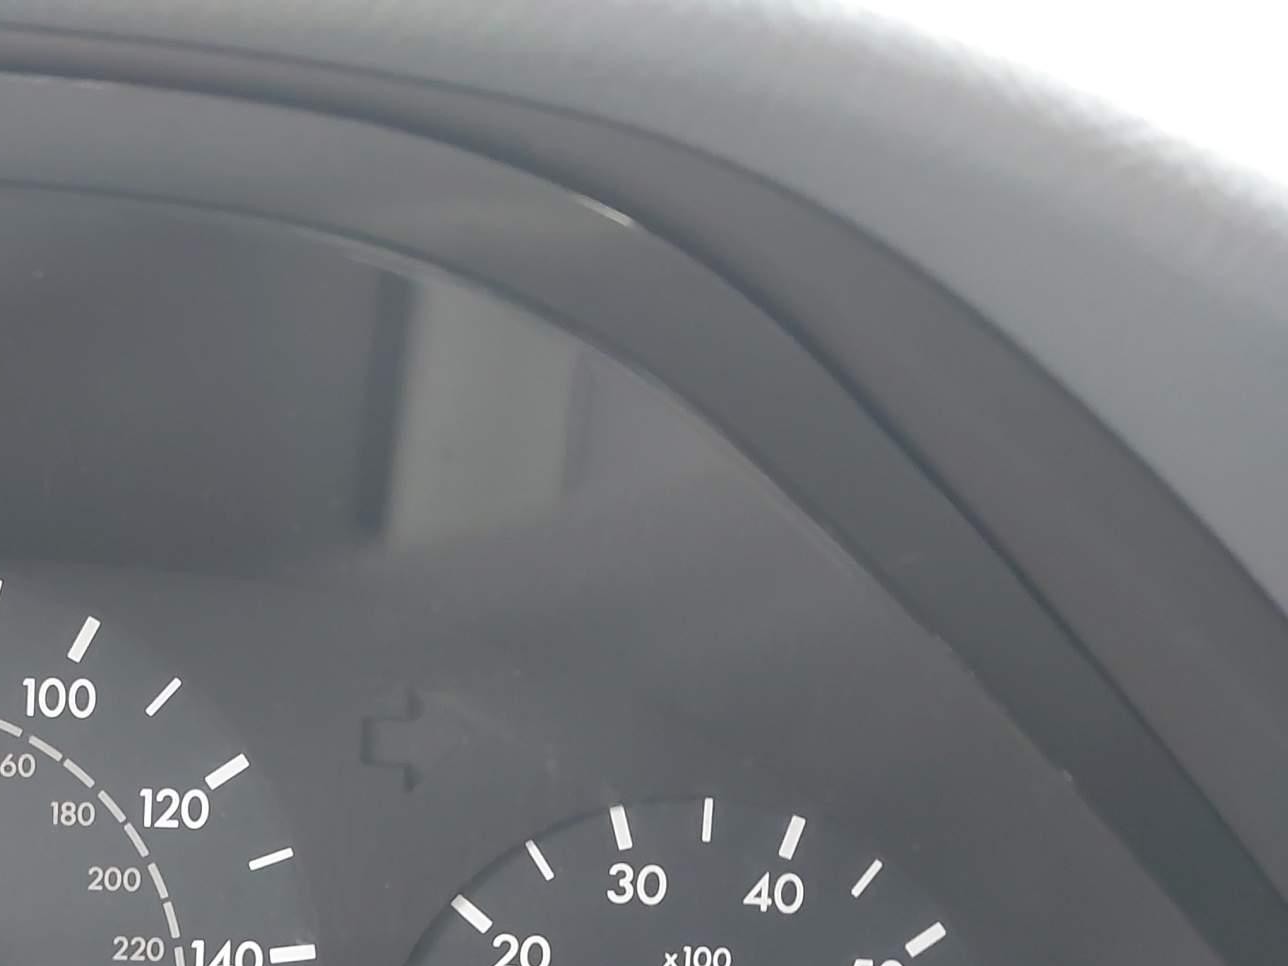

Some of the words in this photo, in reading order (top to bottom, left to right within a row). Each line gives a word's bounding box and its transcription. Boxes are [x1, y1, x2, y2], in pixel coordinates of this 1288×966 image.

[22, 677, 97, 719] 100
[50, 802, 96, 827] 180
[139, 788, 210, 830] 120
[87, 867, 141, 892] 200
[607, 864, 668, 906] 30
[743, 872, 805, 915] 40
[112, 936, 165, 962] 220
